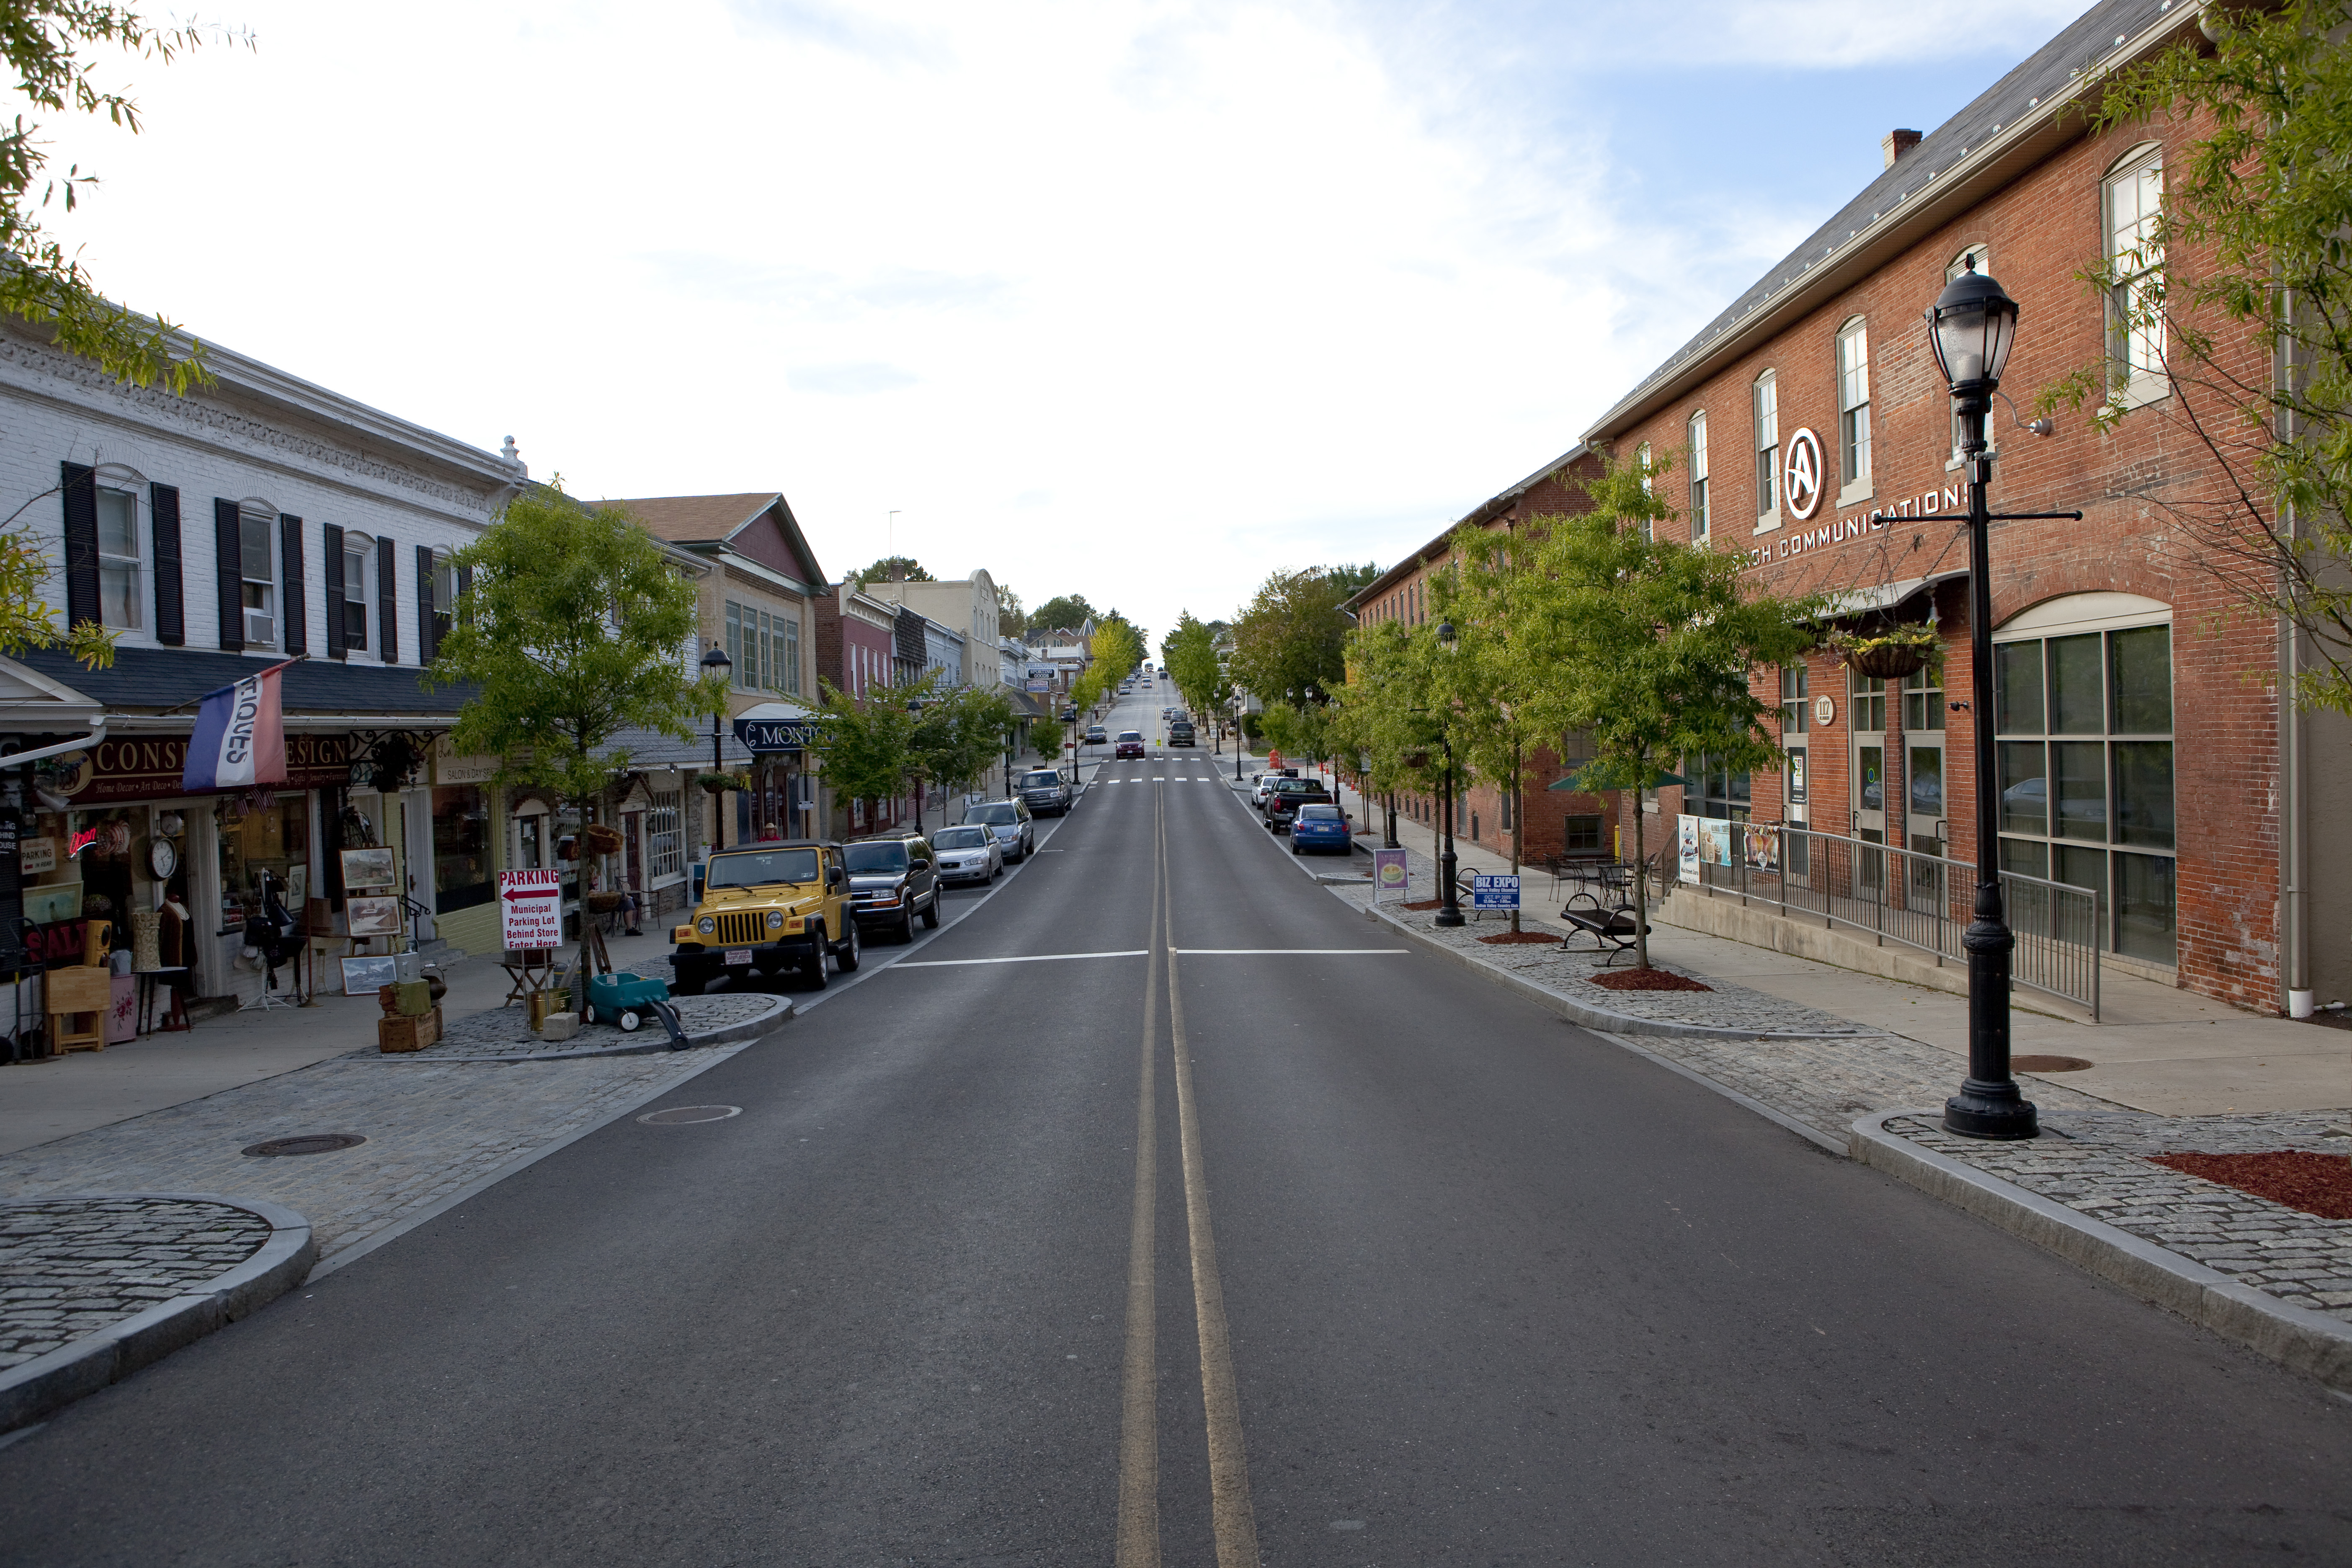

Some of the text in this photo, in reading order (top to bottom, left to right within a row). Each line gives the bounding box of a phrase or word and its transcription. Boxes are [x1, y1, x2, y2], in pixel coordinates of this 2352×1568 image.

[1819, 700, 1830, 715] 117
[227, 676, 258, 763] TIQUES
[97, 741, 346, 771] CONSI ESIGN
[448, 769, 466, 780] SALON
[467, 769, 471, 779] &
[472, 769, 482, 778] DAY
[96, 782, 114, 794] Home
[116, 782, 135, 792] Decor
[139, 781, 151, 792] Art
[152, 781, 167, 790] Deco
[172, 780, 183, 789] Des
[294, 772, 306, 785] Gifts
[309, 771, 326, 784] Jewelry
[69, 828, 96, 855] Open
[22, 849, 52, 861] PARKING
[500, 869, 559, 886] PARKING
[1476, 877, 1518, 888] BIZ EXPO
[511, 904, 551, 915] Municipal
[509, 916, 555, 927] Parking Lot
[507, 928, 558, 939] Behind Store
